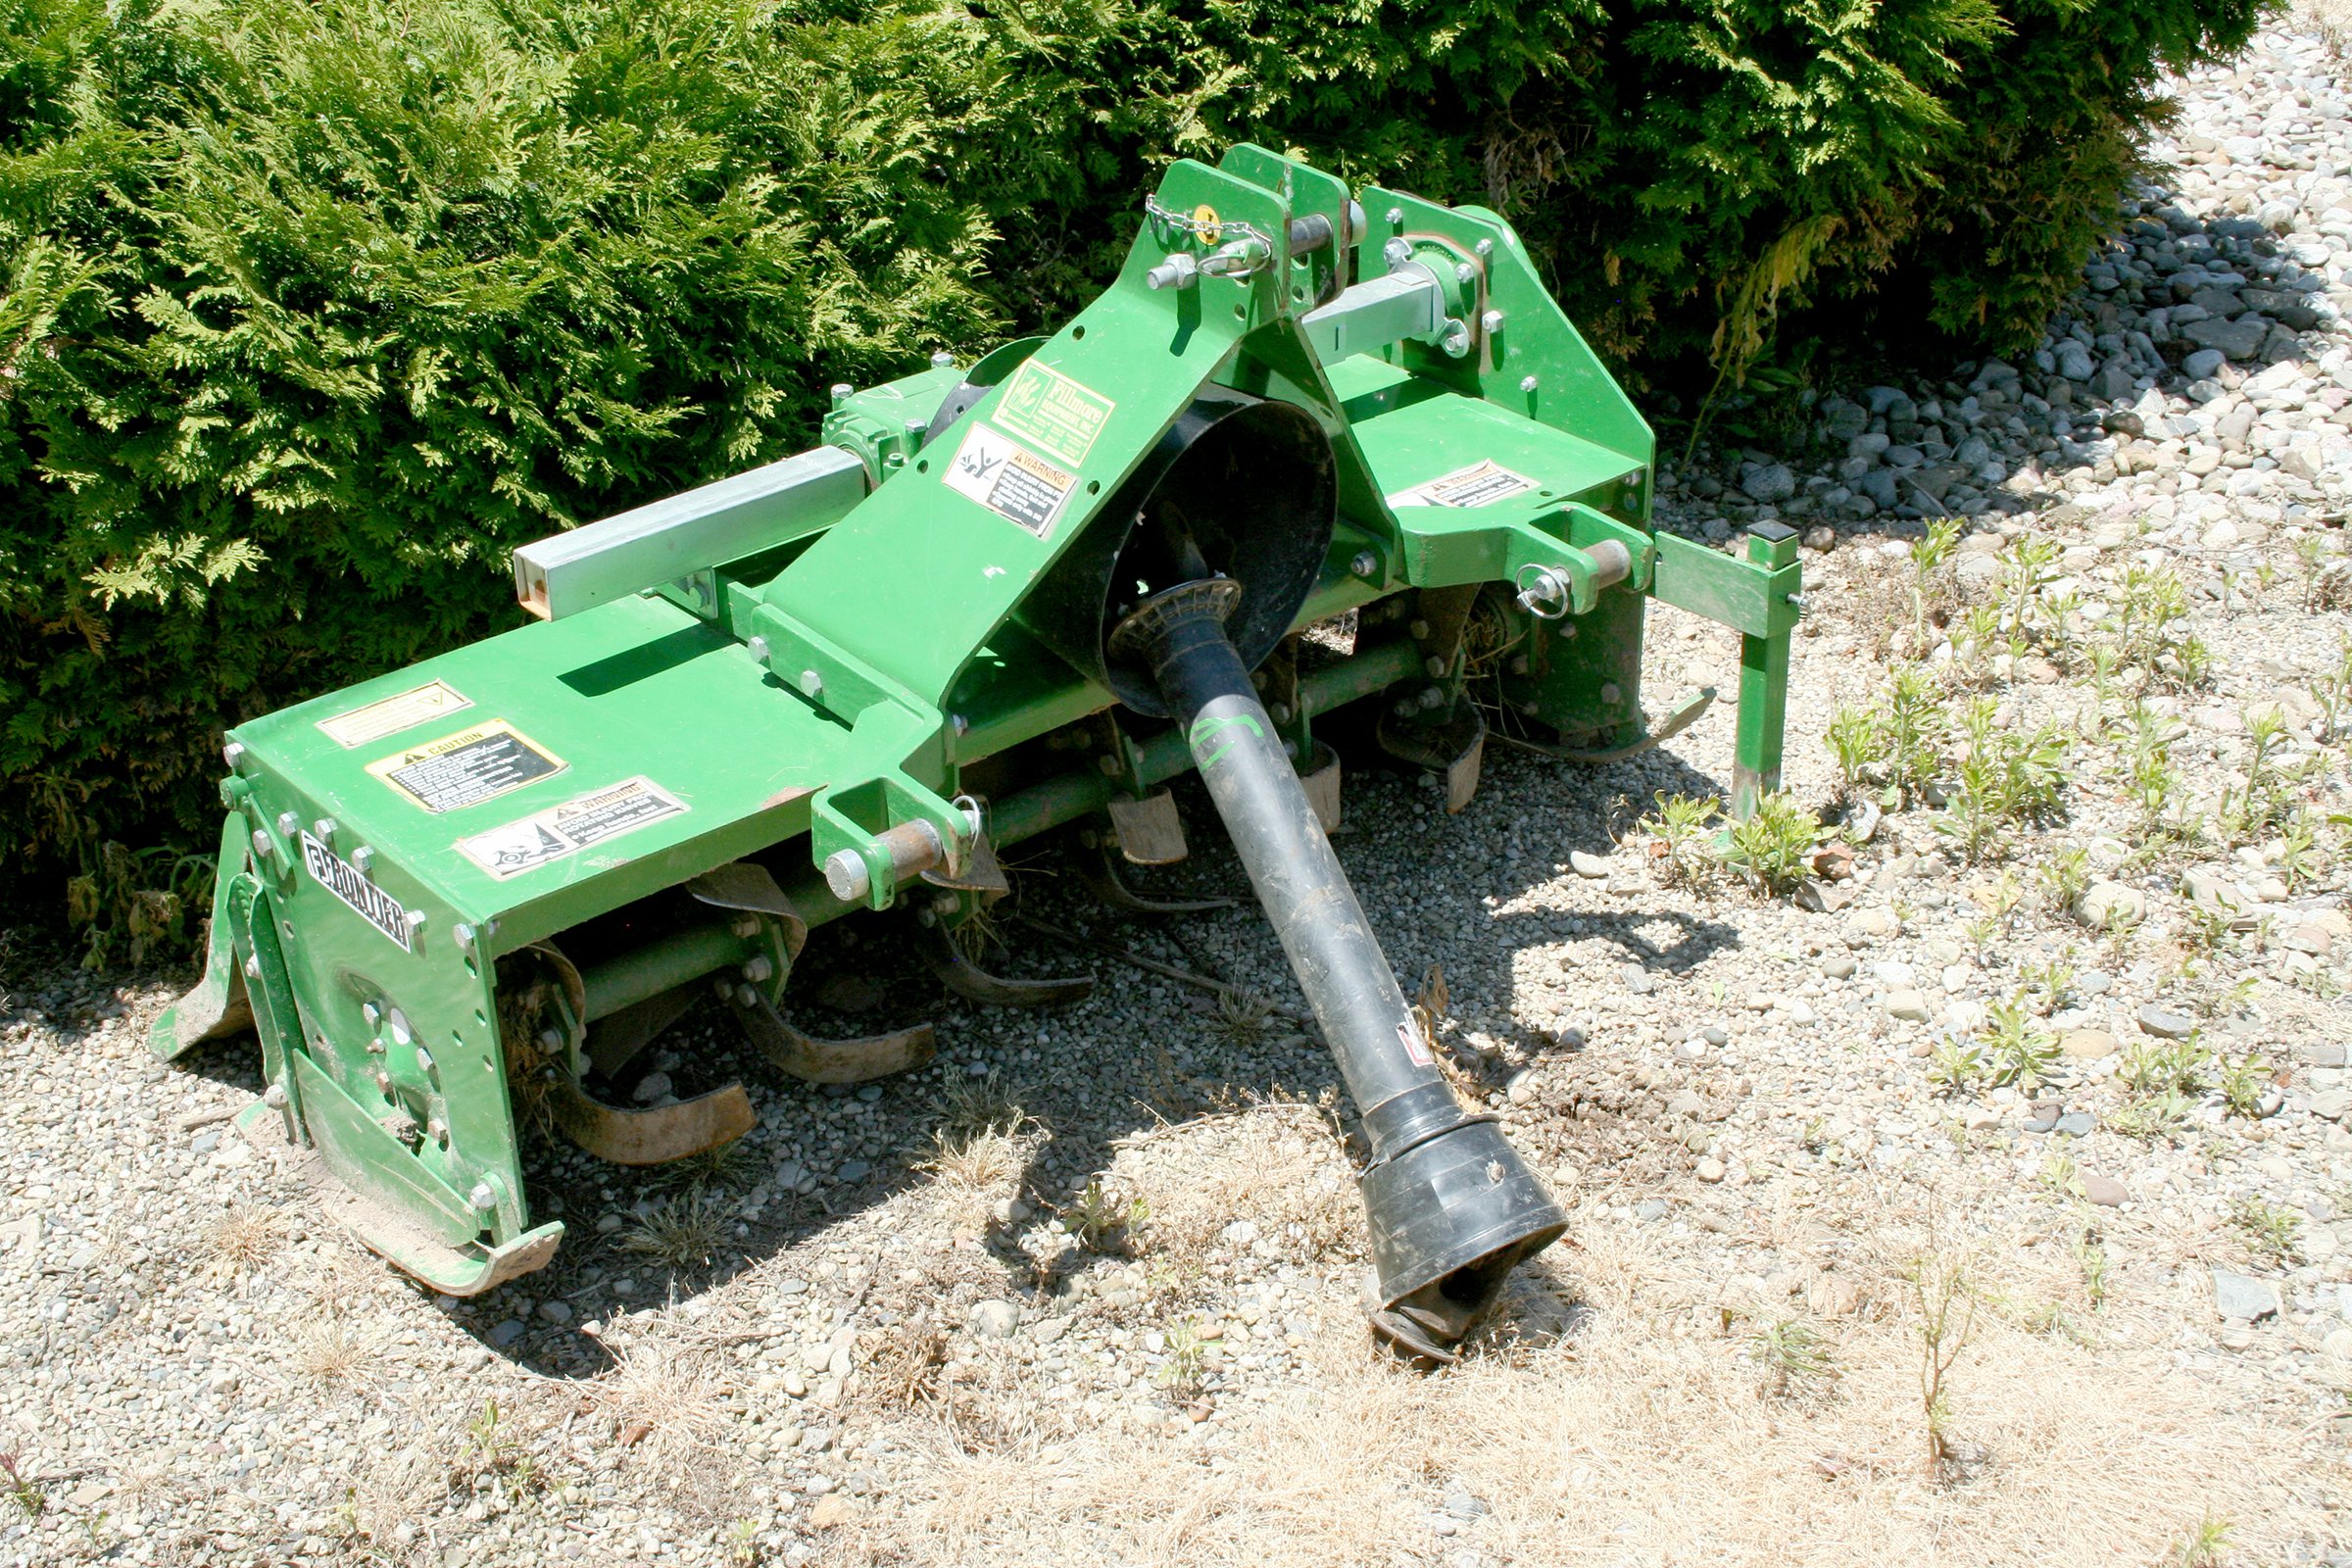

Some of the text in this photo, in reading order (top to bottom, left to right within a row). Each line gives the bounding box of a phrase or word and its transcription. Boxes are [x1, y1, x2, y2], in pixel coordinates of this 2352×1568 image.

[1049, 381, 1103, 423] Fillmore
[1024, 457, 1066, 484] WARNING
[427, 732, 483, 755] CAUTION
[580, 784, 641, 809] WARNING
[559, 813, 590, 829] AVOID
[587, 801, 625, 817] INJURY
[563, 811, 615, 832] ROTATING
[612, 798, 652, 814] KNIVES
[576, 824, 607, 837] Keep
[636, 804, 659, 814] feet
[319, 846, 406, 939] FRONTIER
